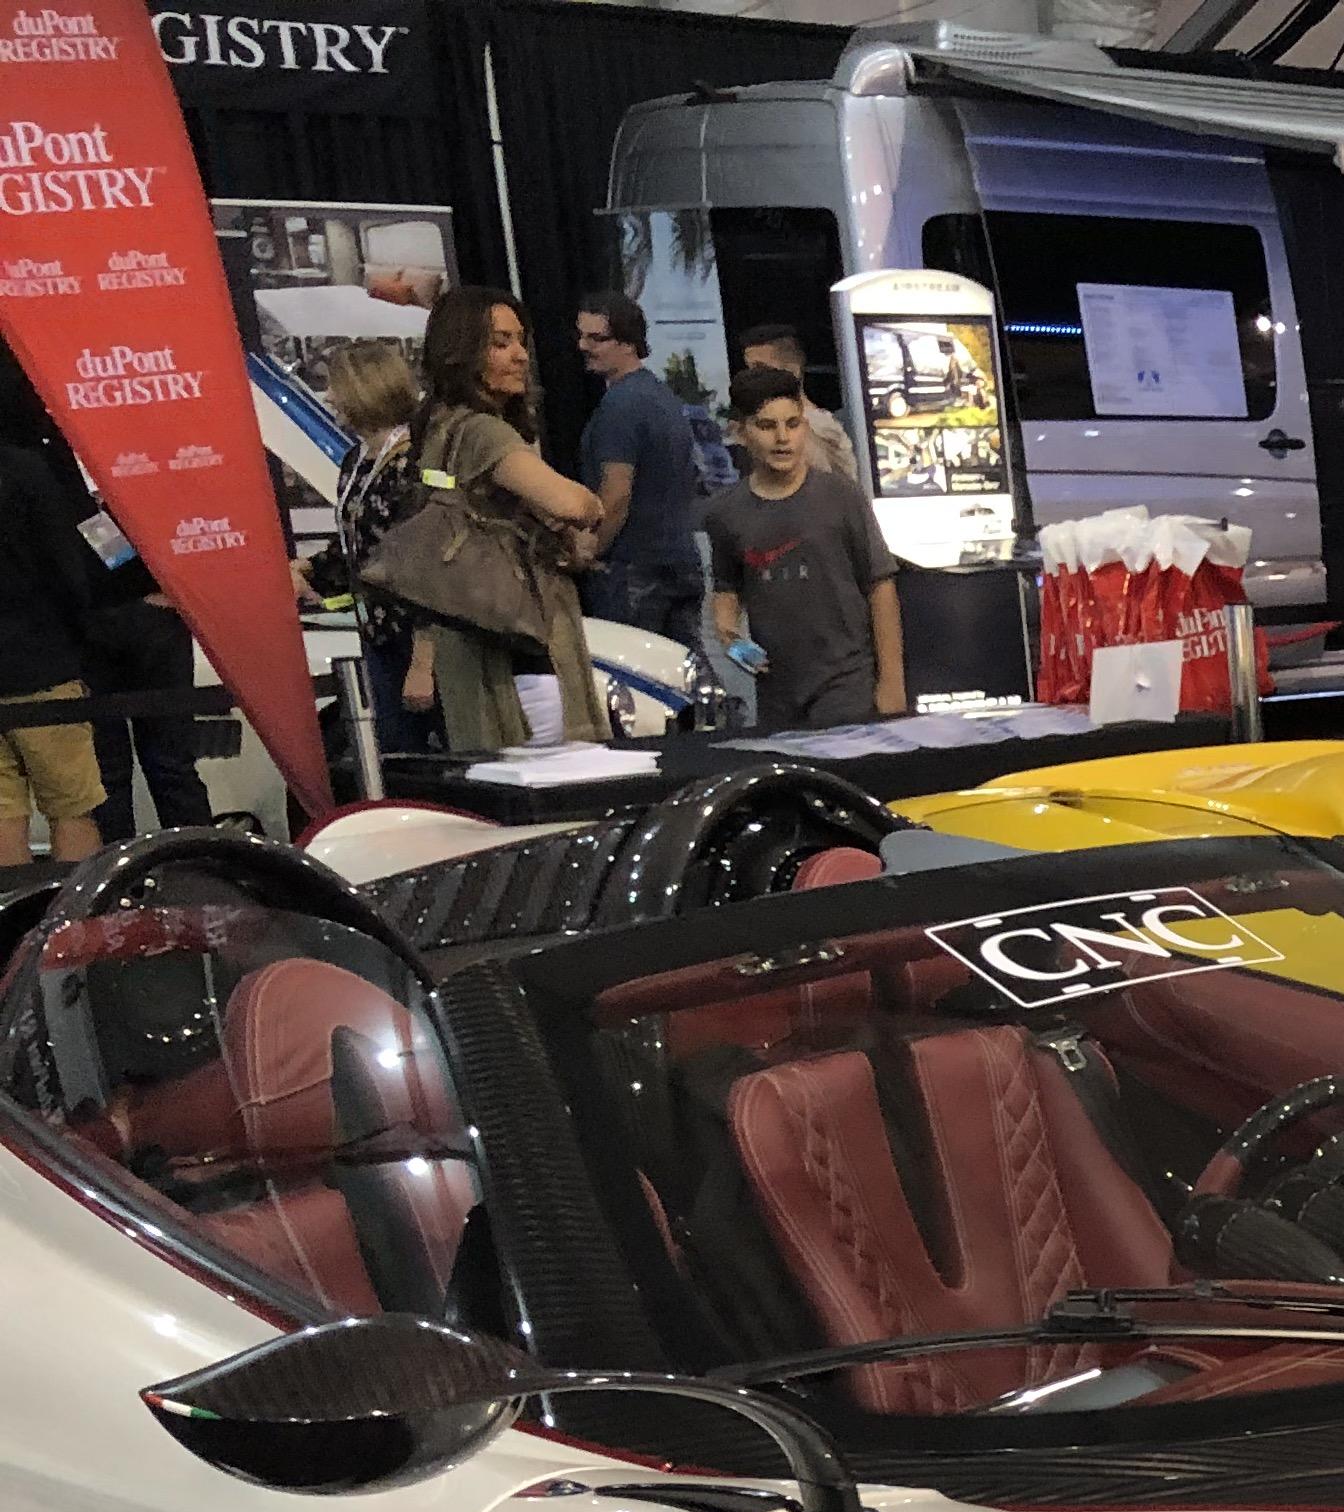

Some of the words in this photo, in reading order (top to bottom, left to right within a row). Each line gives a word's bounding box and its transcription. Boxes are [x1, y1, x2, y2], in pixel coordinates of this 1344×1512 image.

[13, 9, 97, 35] duPont
[0, 37, 119, 62] REGISTRY
[151, 11, 397, 74] GISTRY
[0, 121, 113, 168] uPont
[0, 167, 155, 215] GISTRY
[97, 267, 187, 290] REGISTRY
[108, 250, 169, 271] duPont
[77, 345, 176, 378] duPont
[66, 371, 203, 410] REGISTRY
[980, 904, 1244, 982] CNC
